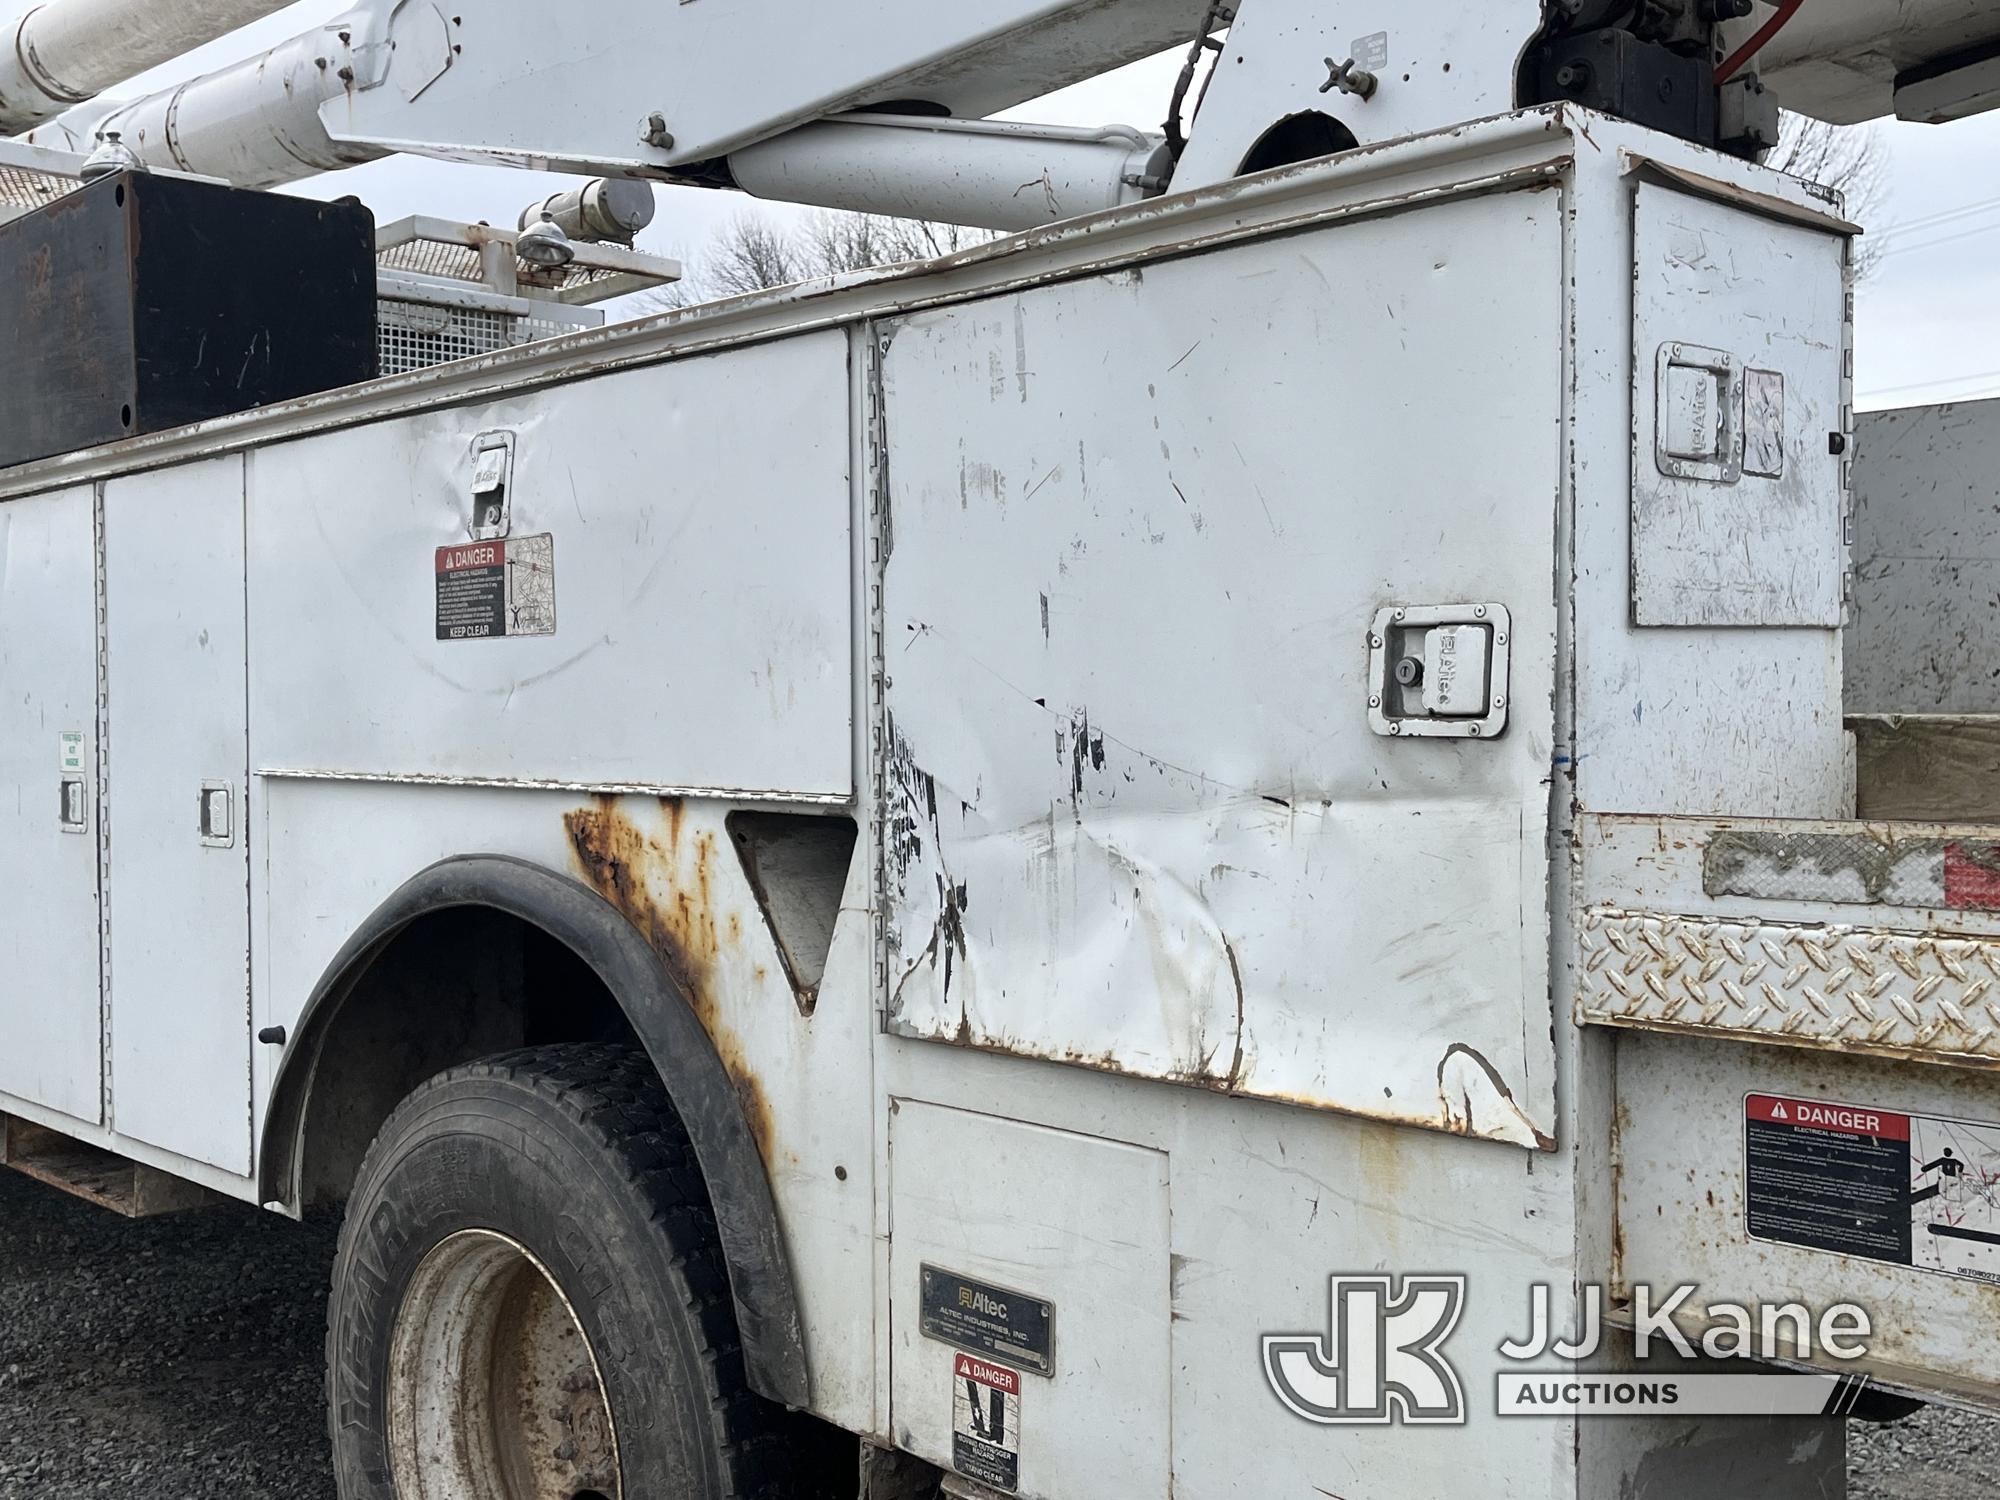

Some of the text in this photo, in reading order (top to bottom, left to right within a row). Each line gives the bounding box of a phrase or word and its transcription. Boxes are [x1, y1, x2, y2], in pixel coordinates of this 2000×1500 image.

[455, 547, 494, 568] DANGER
[449, 624, 490, 638] KEEP CLEAR
[1797, 1105, 1879, 1132] DANGER
[1793, 1126, 1860, 1141] ELECTRICAL HAZARDS
[972, 1292, 1008, 1320] Altec
[940, 1306, 963, 1320] ALTEC
[963, 1314, 1011, 1337] INDUSTRIES,
[1012, 1330, 1030, 1342] INC.
[973, 1364, 1013, 1388] DANGER
[957, 1434, 978, 1447] MOVING
[978, 1442, 1012, 1460] OUTRIGGER
[972, 1446, 995, 1461] HAZARD
[964, 1462, 983, 1476] STAND
[983, 1470, 1004, 1484] CLEAR
